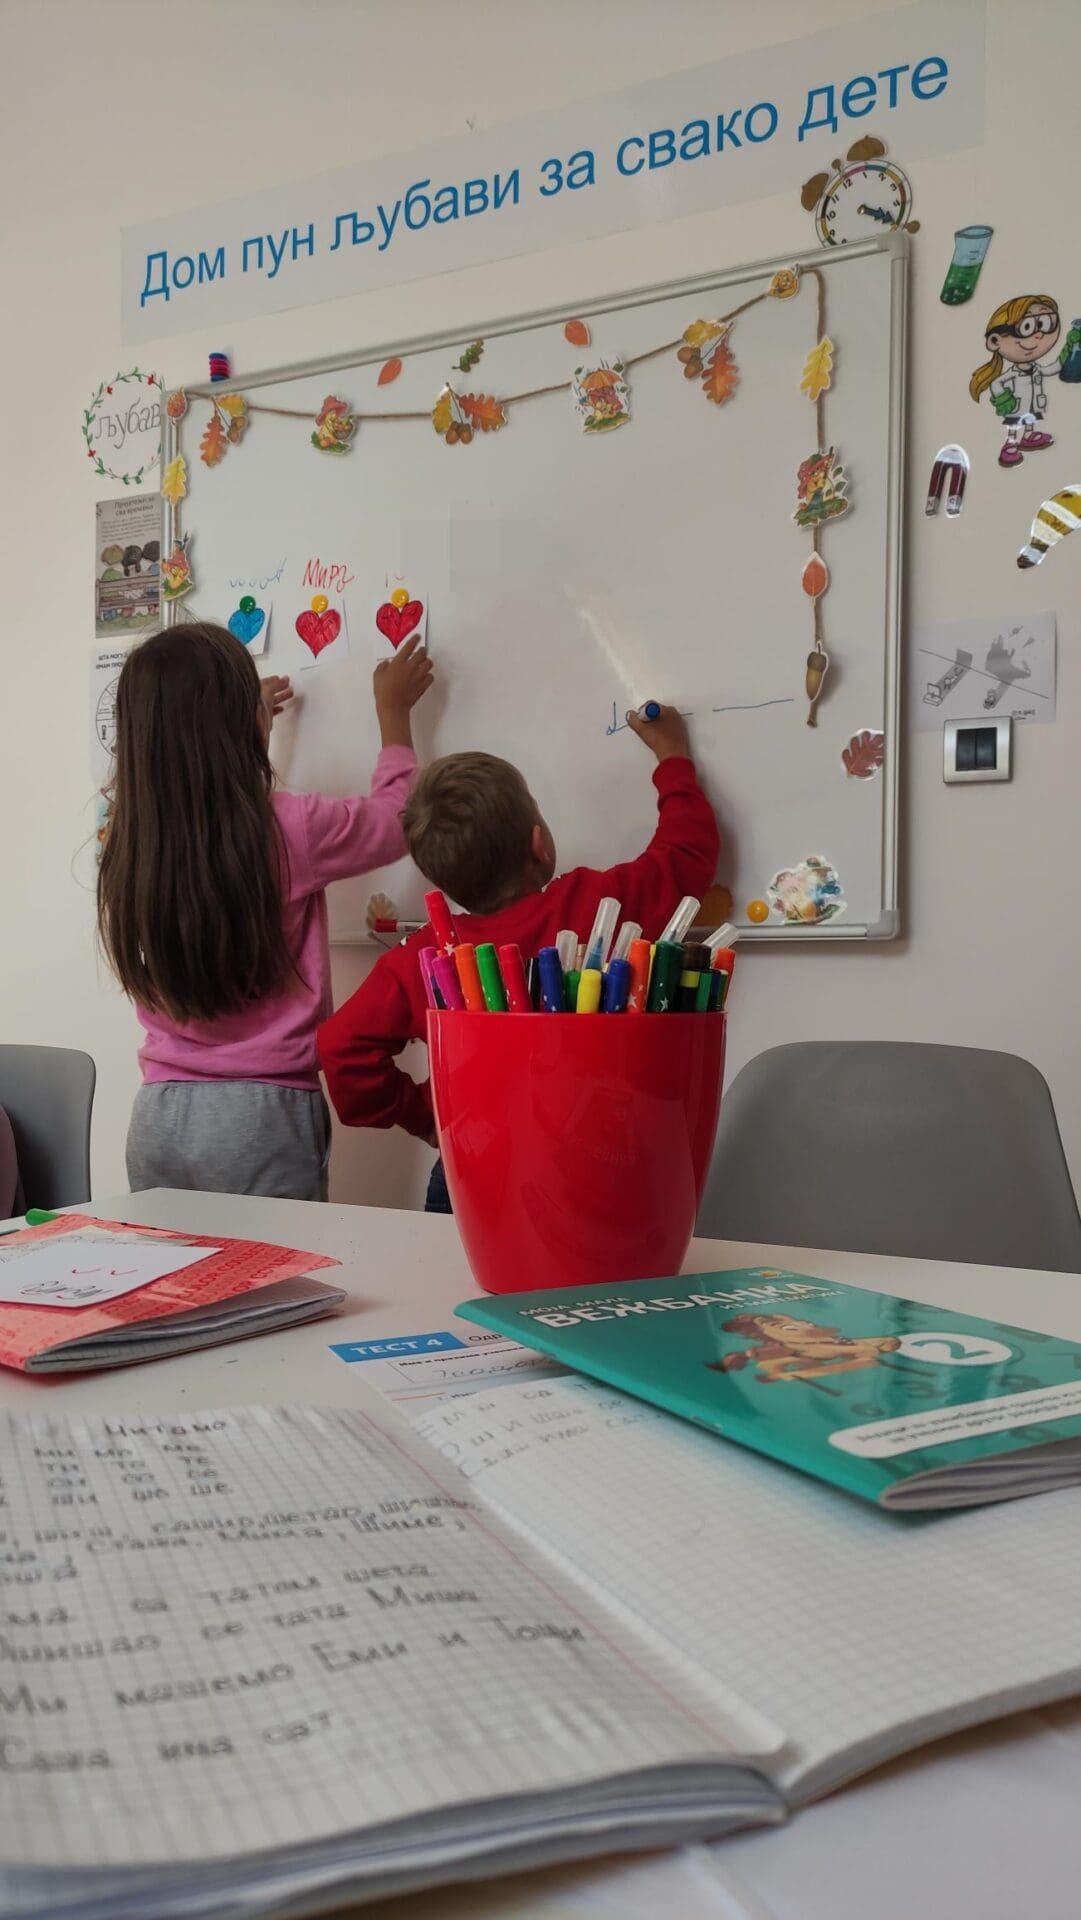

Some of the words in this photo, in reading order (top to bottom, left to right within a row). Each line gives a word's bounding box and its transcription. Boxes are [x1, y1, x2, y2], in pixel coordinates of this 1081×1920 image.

[140, 247, 226, 305] Дом
[242, 224, 315, 278] пун
[331, 169, 520, 251] љубави
[539, 149, 596, 197] за
[616, 102, 779, 176] свако
[798, 56, 949, 141] дете
[533, 1282, 832, 1328] ВЕЖБАНКА
[351, 1340, 417, 1356] ТЕСТ
[426, 1338, 444, 1347] 4
[910, 1339, 993, 1360] 2
